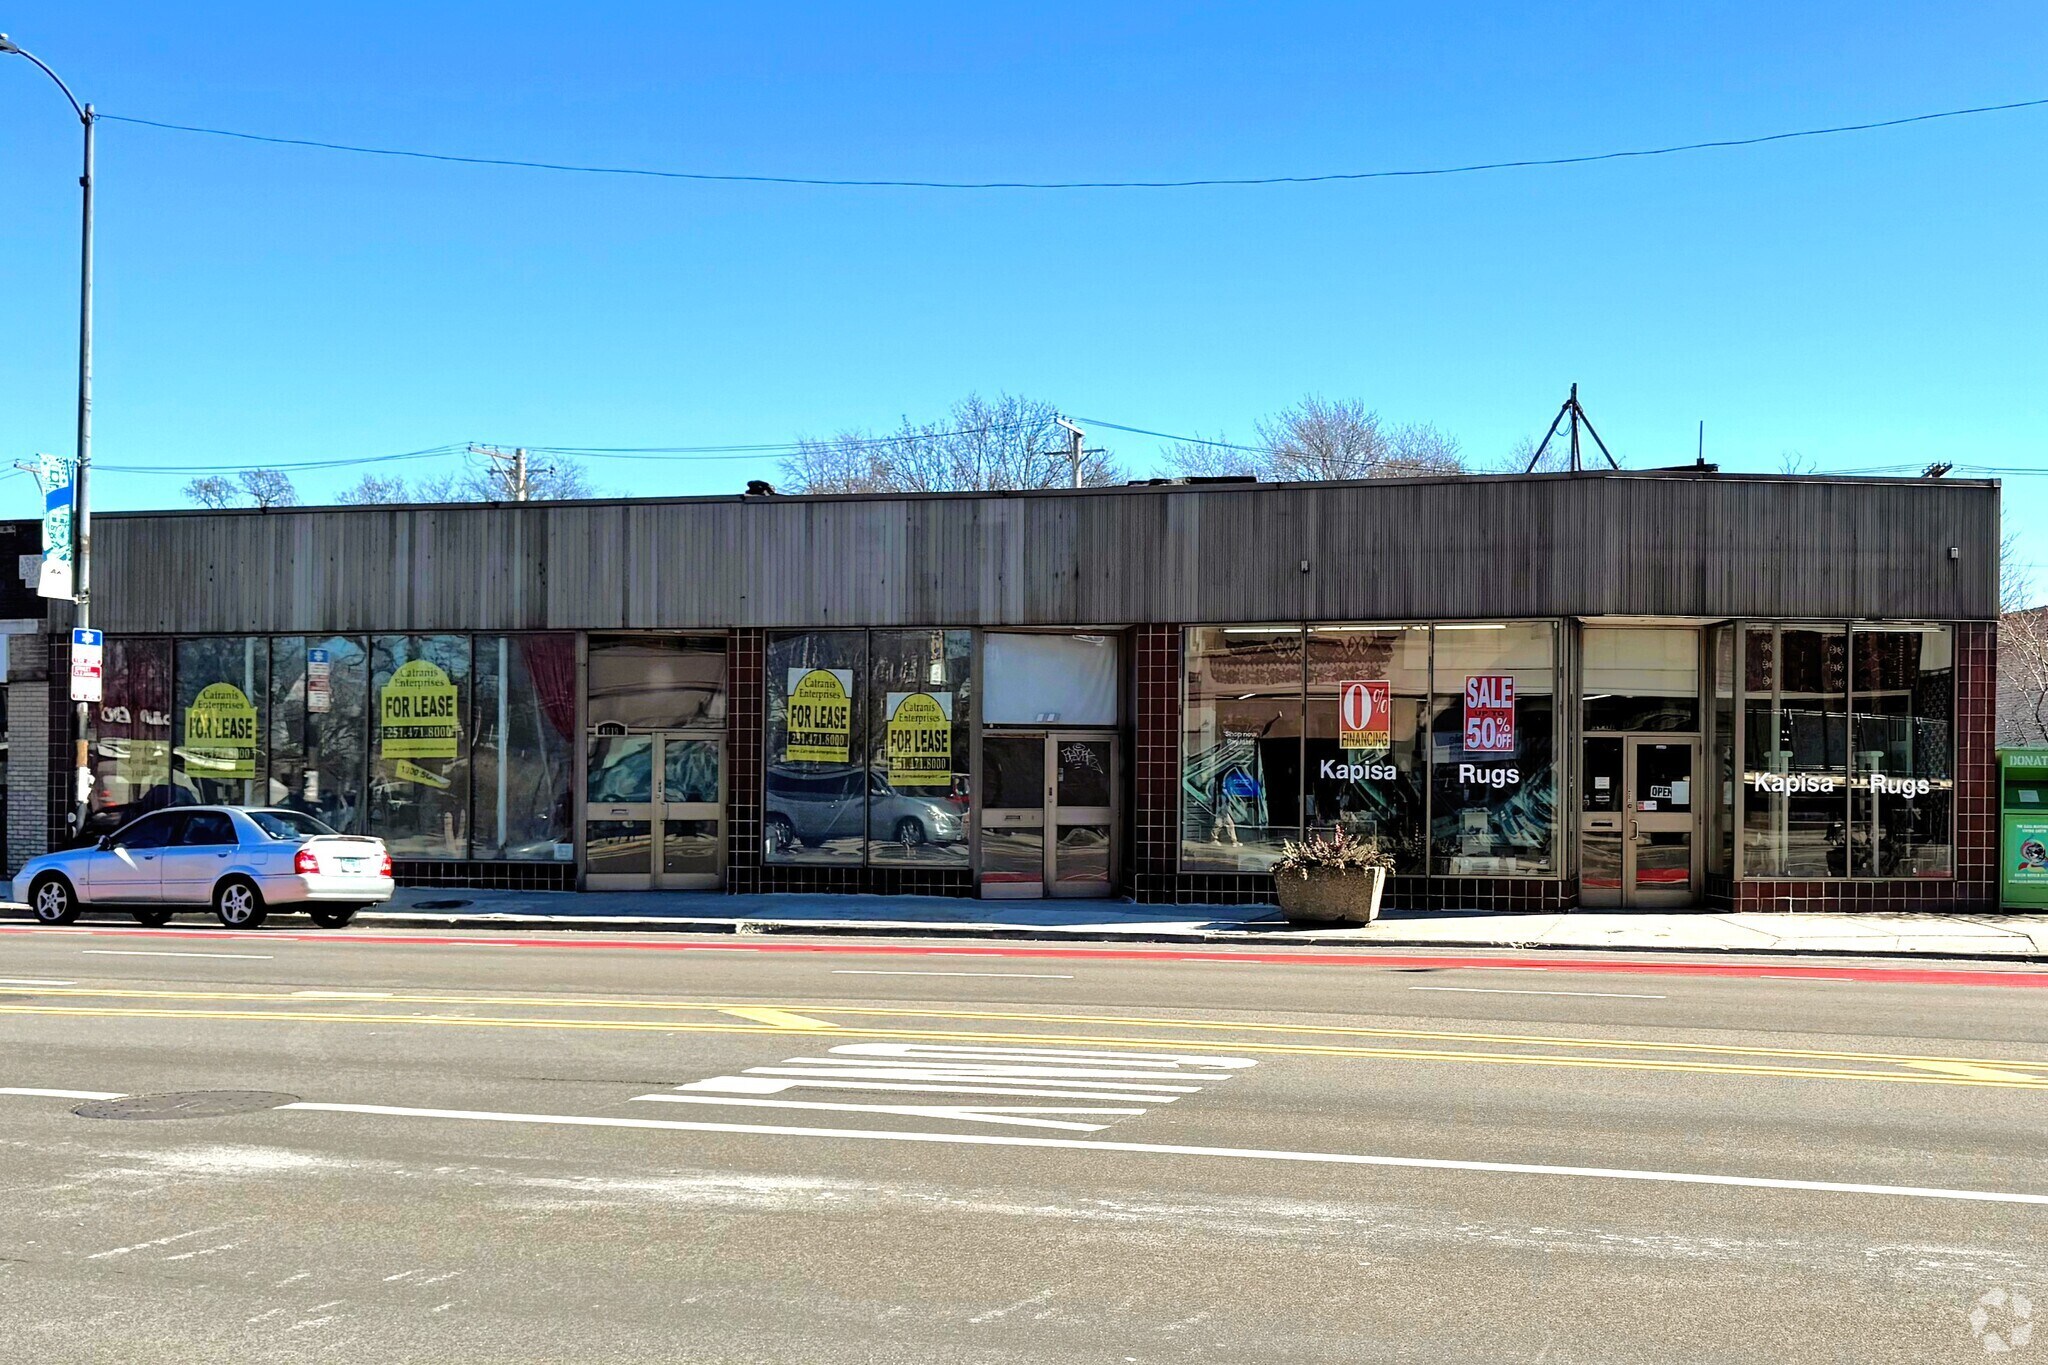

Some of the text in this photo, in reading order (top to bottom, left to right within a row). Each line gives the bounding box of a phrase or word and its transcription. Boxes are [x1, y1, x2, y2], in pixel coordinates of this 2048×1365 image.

[400, 669, 439, 678] Catranis
[395, 679, 445, 690] Enterprises
[804, 678, 836, 689] Catranis
[203, 690, 239, 700] Catranis
[799, 689, 841, 701] Enterprises
[1467, 678, 1512, 708] SALE
[198, 701, 244, 711] Enterprises
[386, 695, 454, 718] FOR LEASE
[903, 702, 935, 712] Catranis
[791, 705, 847, 729] FOR LEASE
[899, 713, 940, 724] Enterprises
[189, 717, 253, 738] FOR LEASE
[891, 730, 948, 752] FOR LEASE
[1342, 732, 1388, 747] FINANCING
[1496, 734, 1511, 748] OFF
[1320, 759, 1519, 788] Kapisa Rugs
[1754, 772, 1930, 798] Kapisa Rugs
